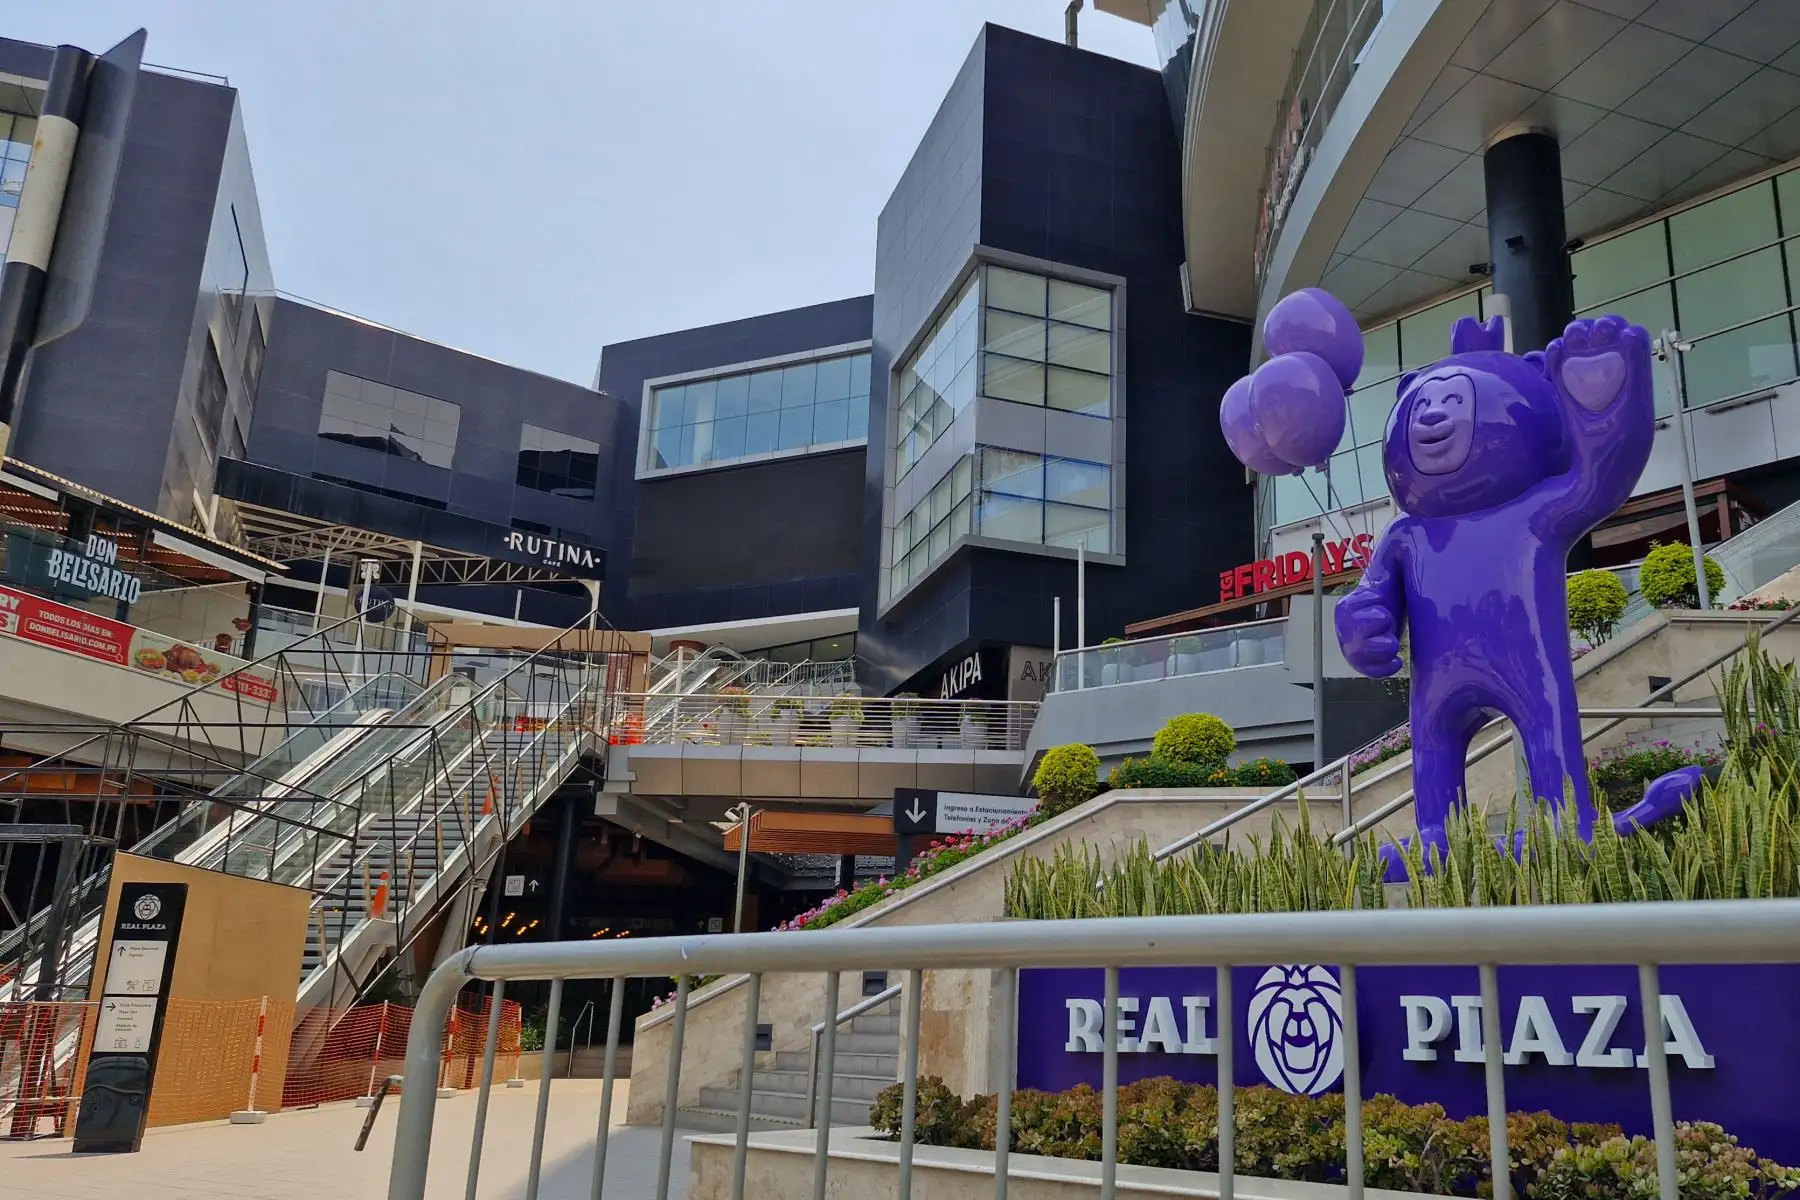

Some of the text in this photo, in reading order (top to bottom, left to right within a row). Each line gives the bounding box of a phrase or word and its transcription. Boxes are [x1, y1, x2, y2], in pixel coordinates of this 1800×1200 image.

[86, 534, 118, 566] DON
[509, 531, 594, 569] RUTINA
[1234, 533, 1374, 598] FRIDAYS
[47, 548, 141, 605] BELISARIO
[29, 622, 118, 653] DONBELISARIO.COM.PE
[39, 609, 65, 624] TODOS
[66, 618, 82, 629] LOS
[940, 652, 982, 700] AKIPA
[1065, 995, 1716, 1069] REAL PLAZA
